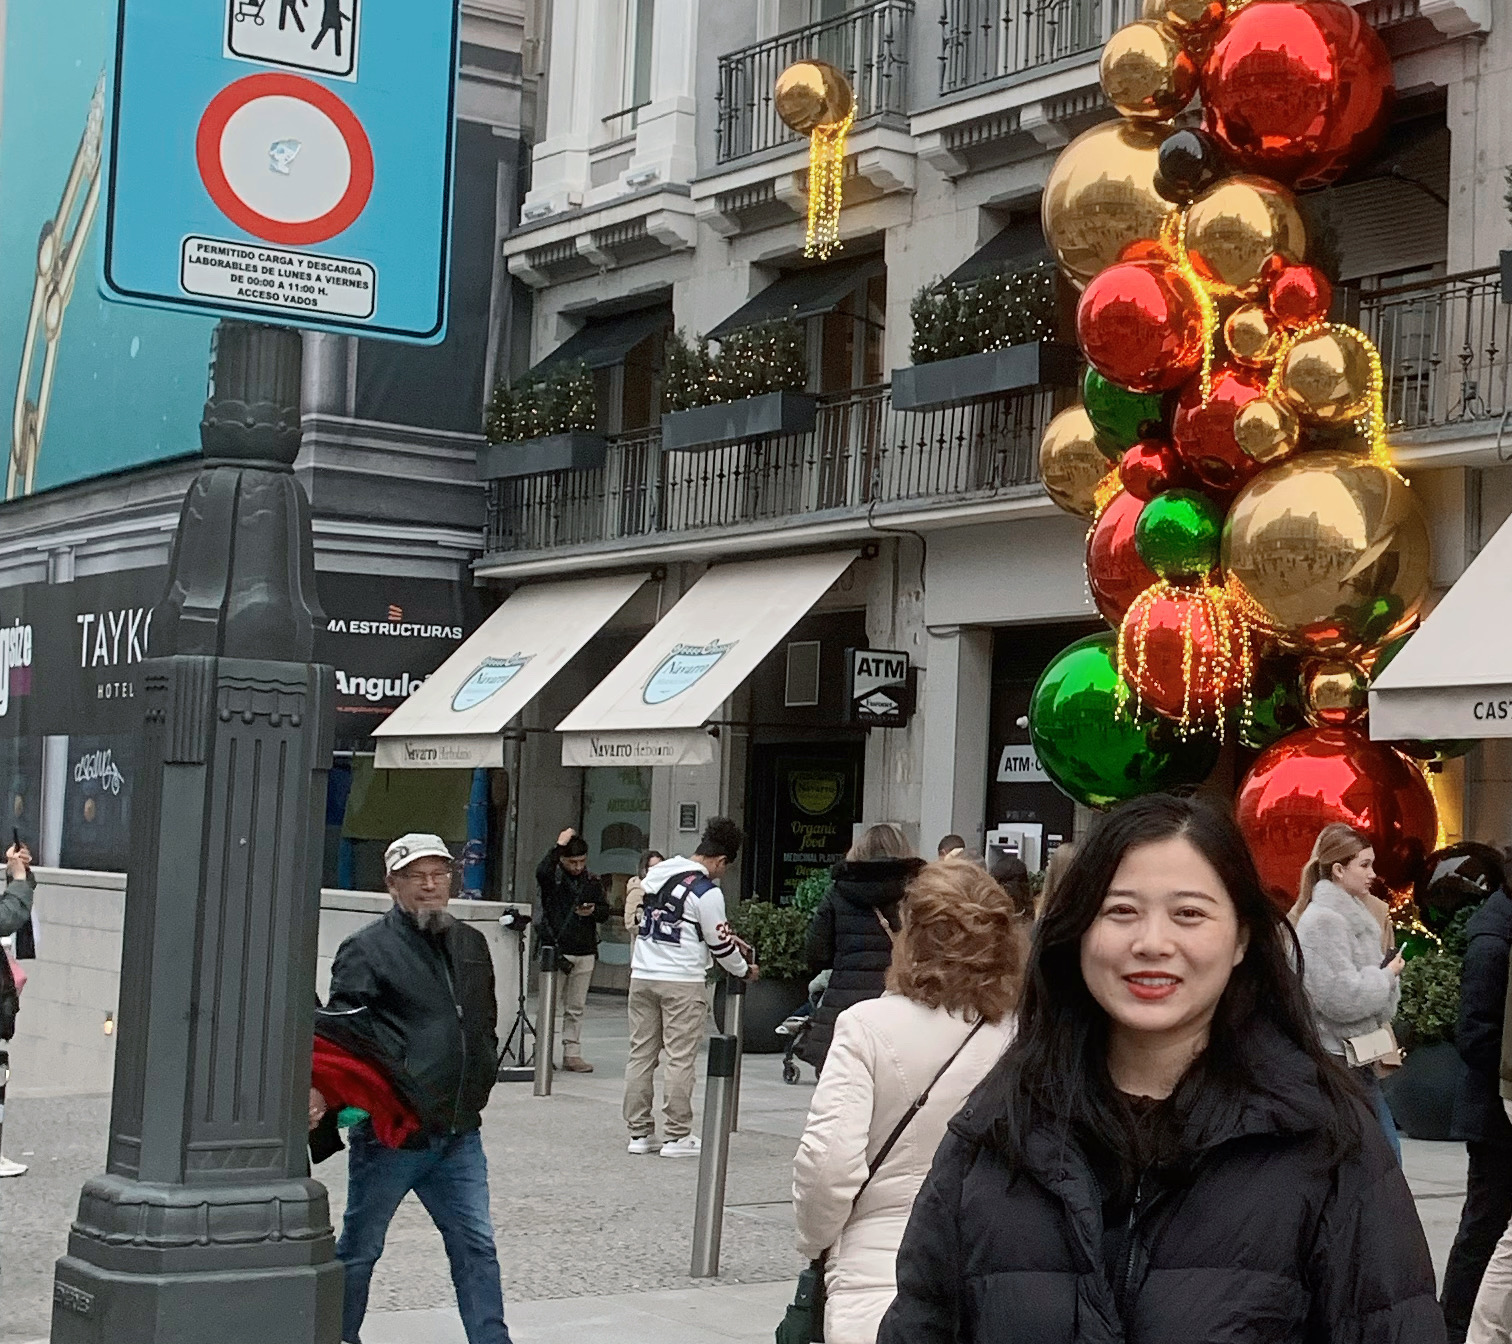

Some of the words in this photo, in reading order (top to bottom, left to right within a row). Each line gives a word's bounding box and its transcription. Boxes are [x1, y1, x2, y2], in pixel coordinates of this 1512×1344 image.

[196, 242, 256, 261] PERMITIDO
[258, 252, 295, 267] CARGA
[298, 258, 305, 268] Y
[307, 260, 363, 277] DESCARGA
[188, 254, 259, 274] LABORABLES
[261, 265, 275, 276] DE
[278, 268, 312, 282] LUNES
[314, 274, 322, 283] A
[325, 275, 370, 290] VIERNES
[230, 273, 244, 285] DE
[247, 276, 275, 289] 00:00
[277, 281, 285, 291] A
[289, 282, 315, 295] 11:00
[317, 286, 329, 297] H.
[237, 287, 280, 302] ACCESO
[282, 293, 318, 307] VADOS
[349, 621, 463, 640] ESTRUCTURAS
[857, 657, 904, 679] ATM
[97, 681, 135, 700] HOTEL
[404, 742, 438, 761] Navarro
[590, 737, 632, 758] Navarro
[791, 821, 837, 838] Organic
[800, 835, 827, 851] food
